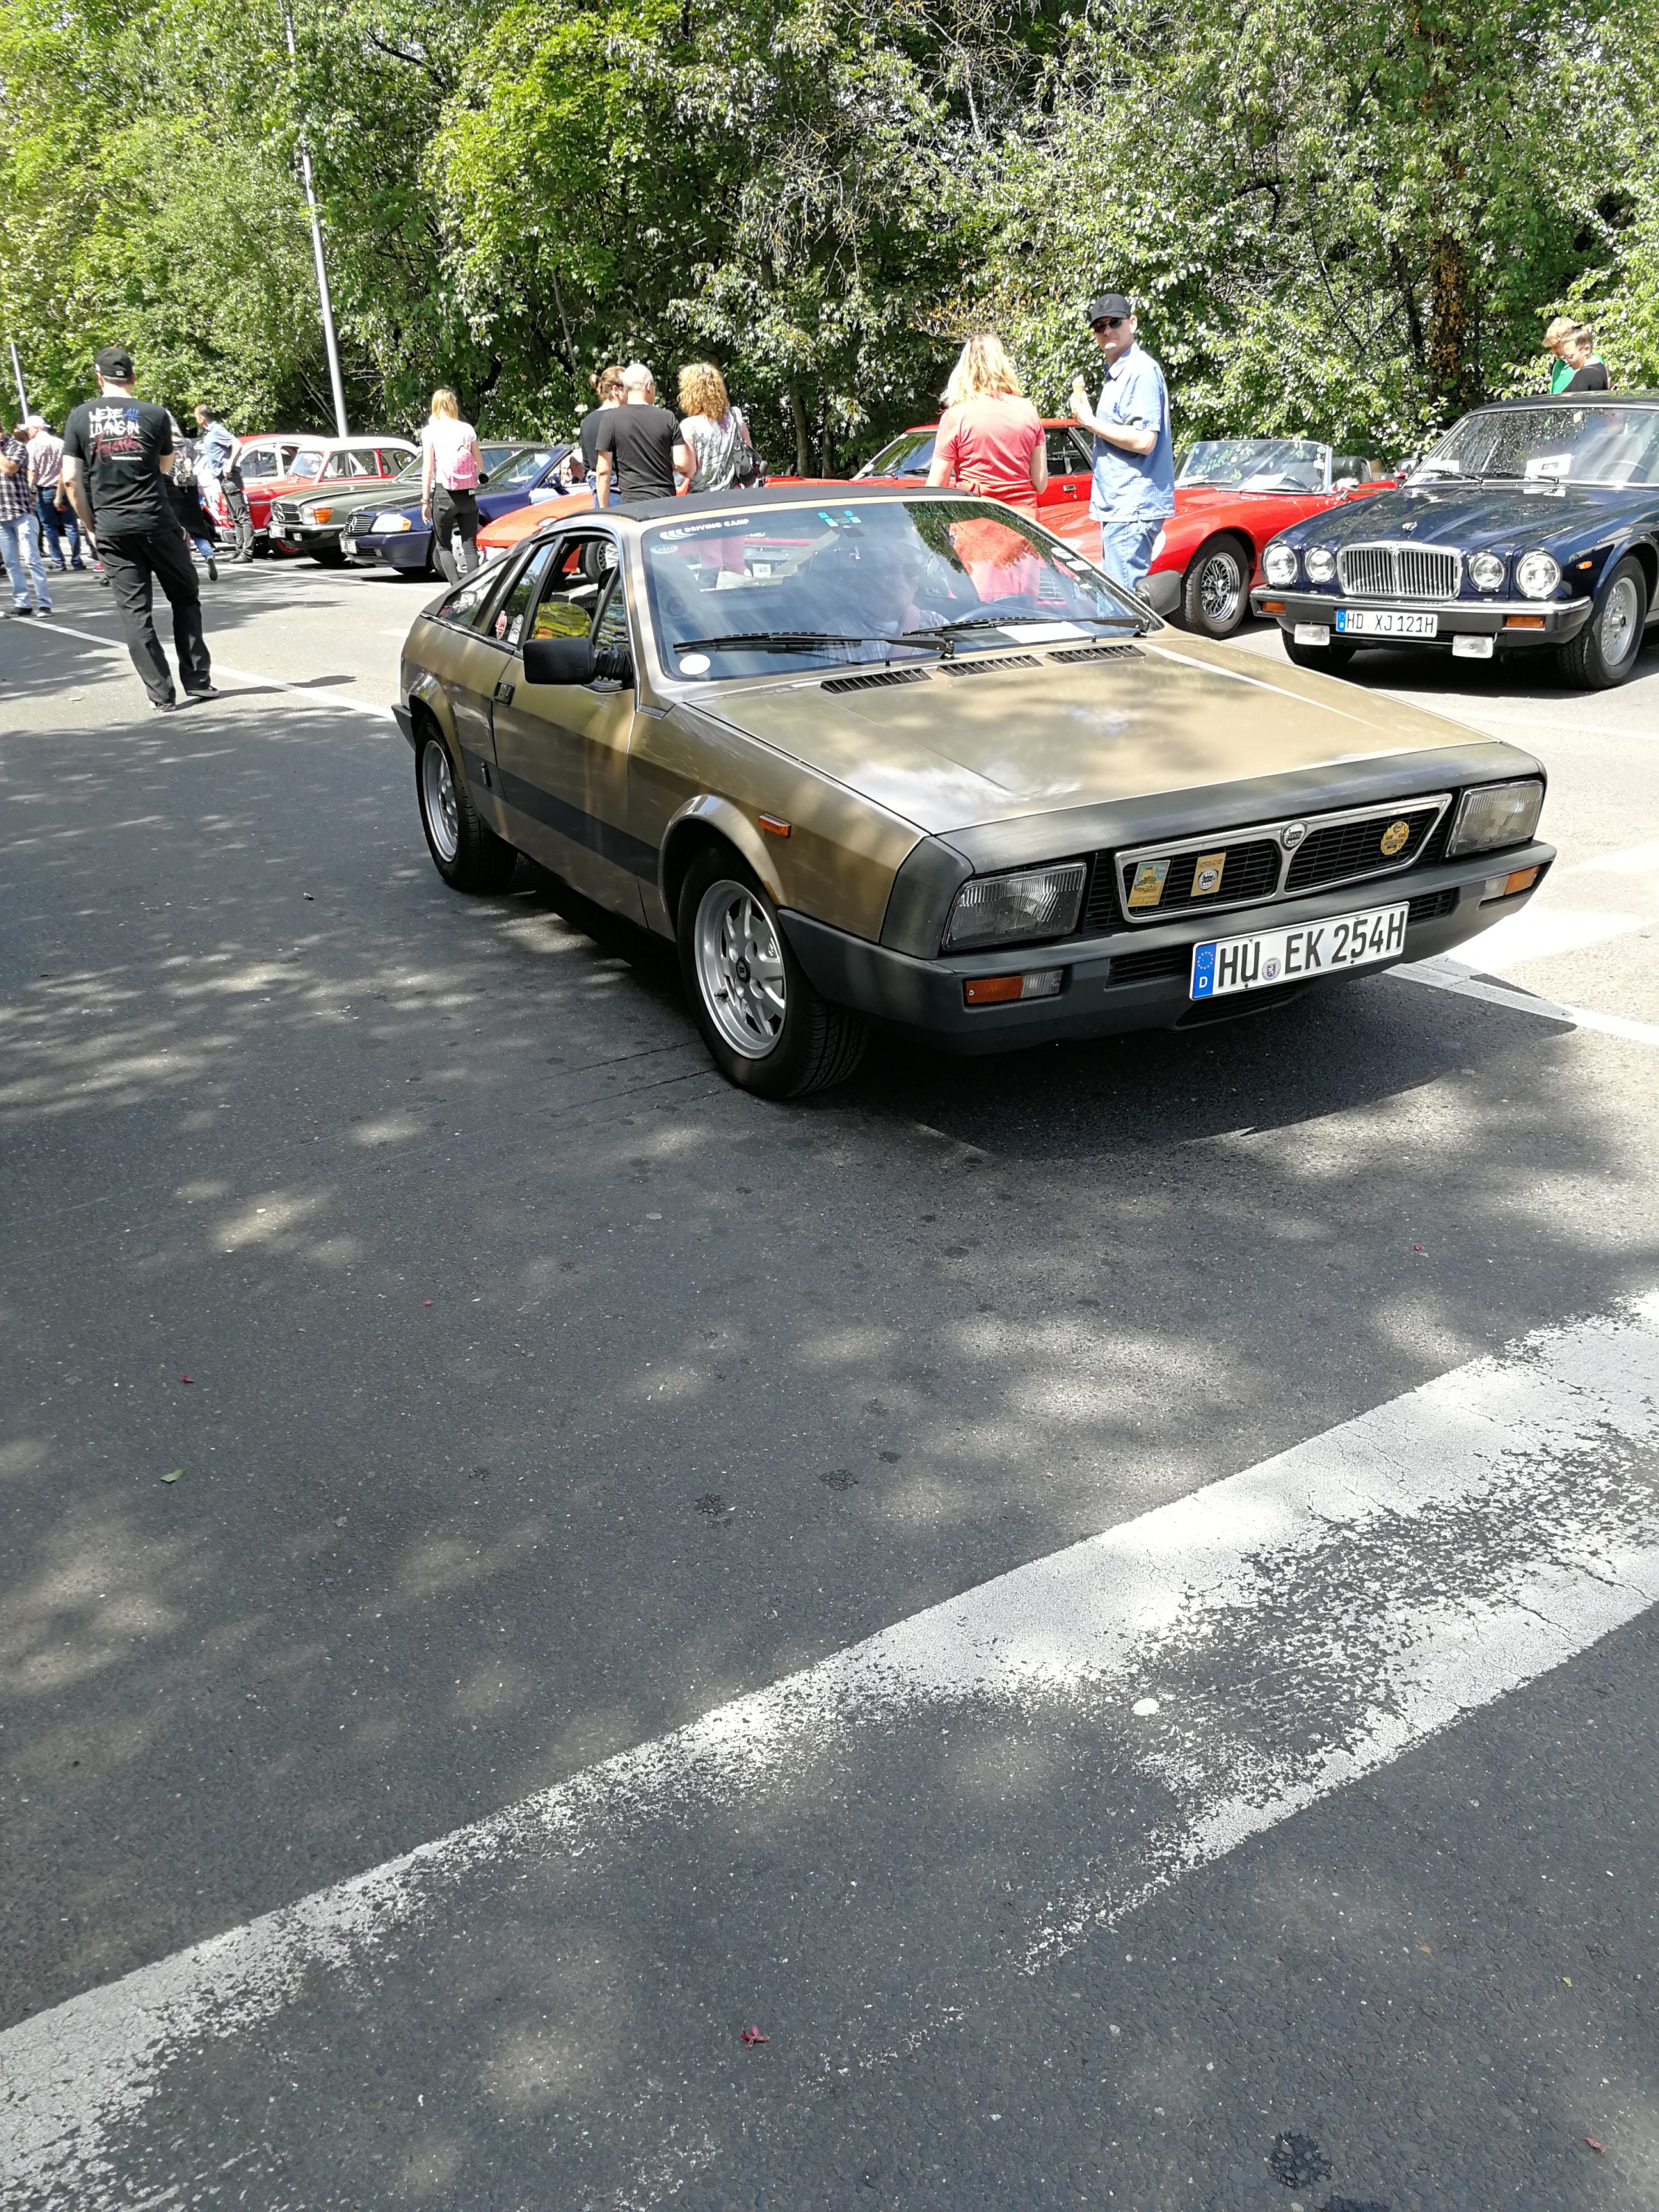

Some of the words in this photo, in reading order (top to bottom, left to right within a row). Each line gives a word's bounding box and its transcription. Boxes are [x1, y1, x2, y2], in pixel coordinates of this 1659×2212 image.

[684, 523, 722, 532] DRIVING
[723, 518, 749, 527] CAMP
[1346, 613, 1363, 629] HD
[1374, 614, 1393, 631] XJ
[1397, 616, 1434, 633] 121H
[1218, 941, 1261, 988] HU
[1284, 928, 1325, 975] EK
[1331, 911, 1405, 964] 254H
[1198, 975, 1208, 989] D
